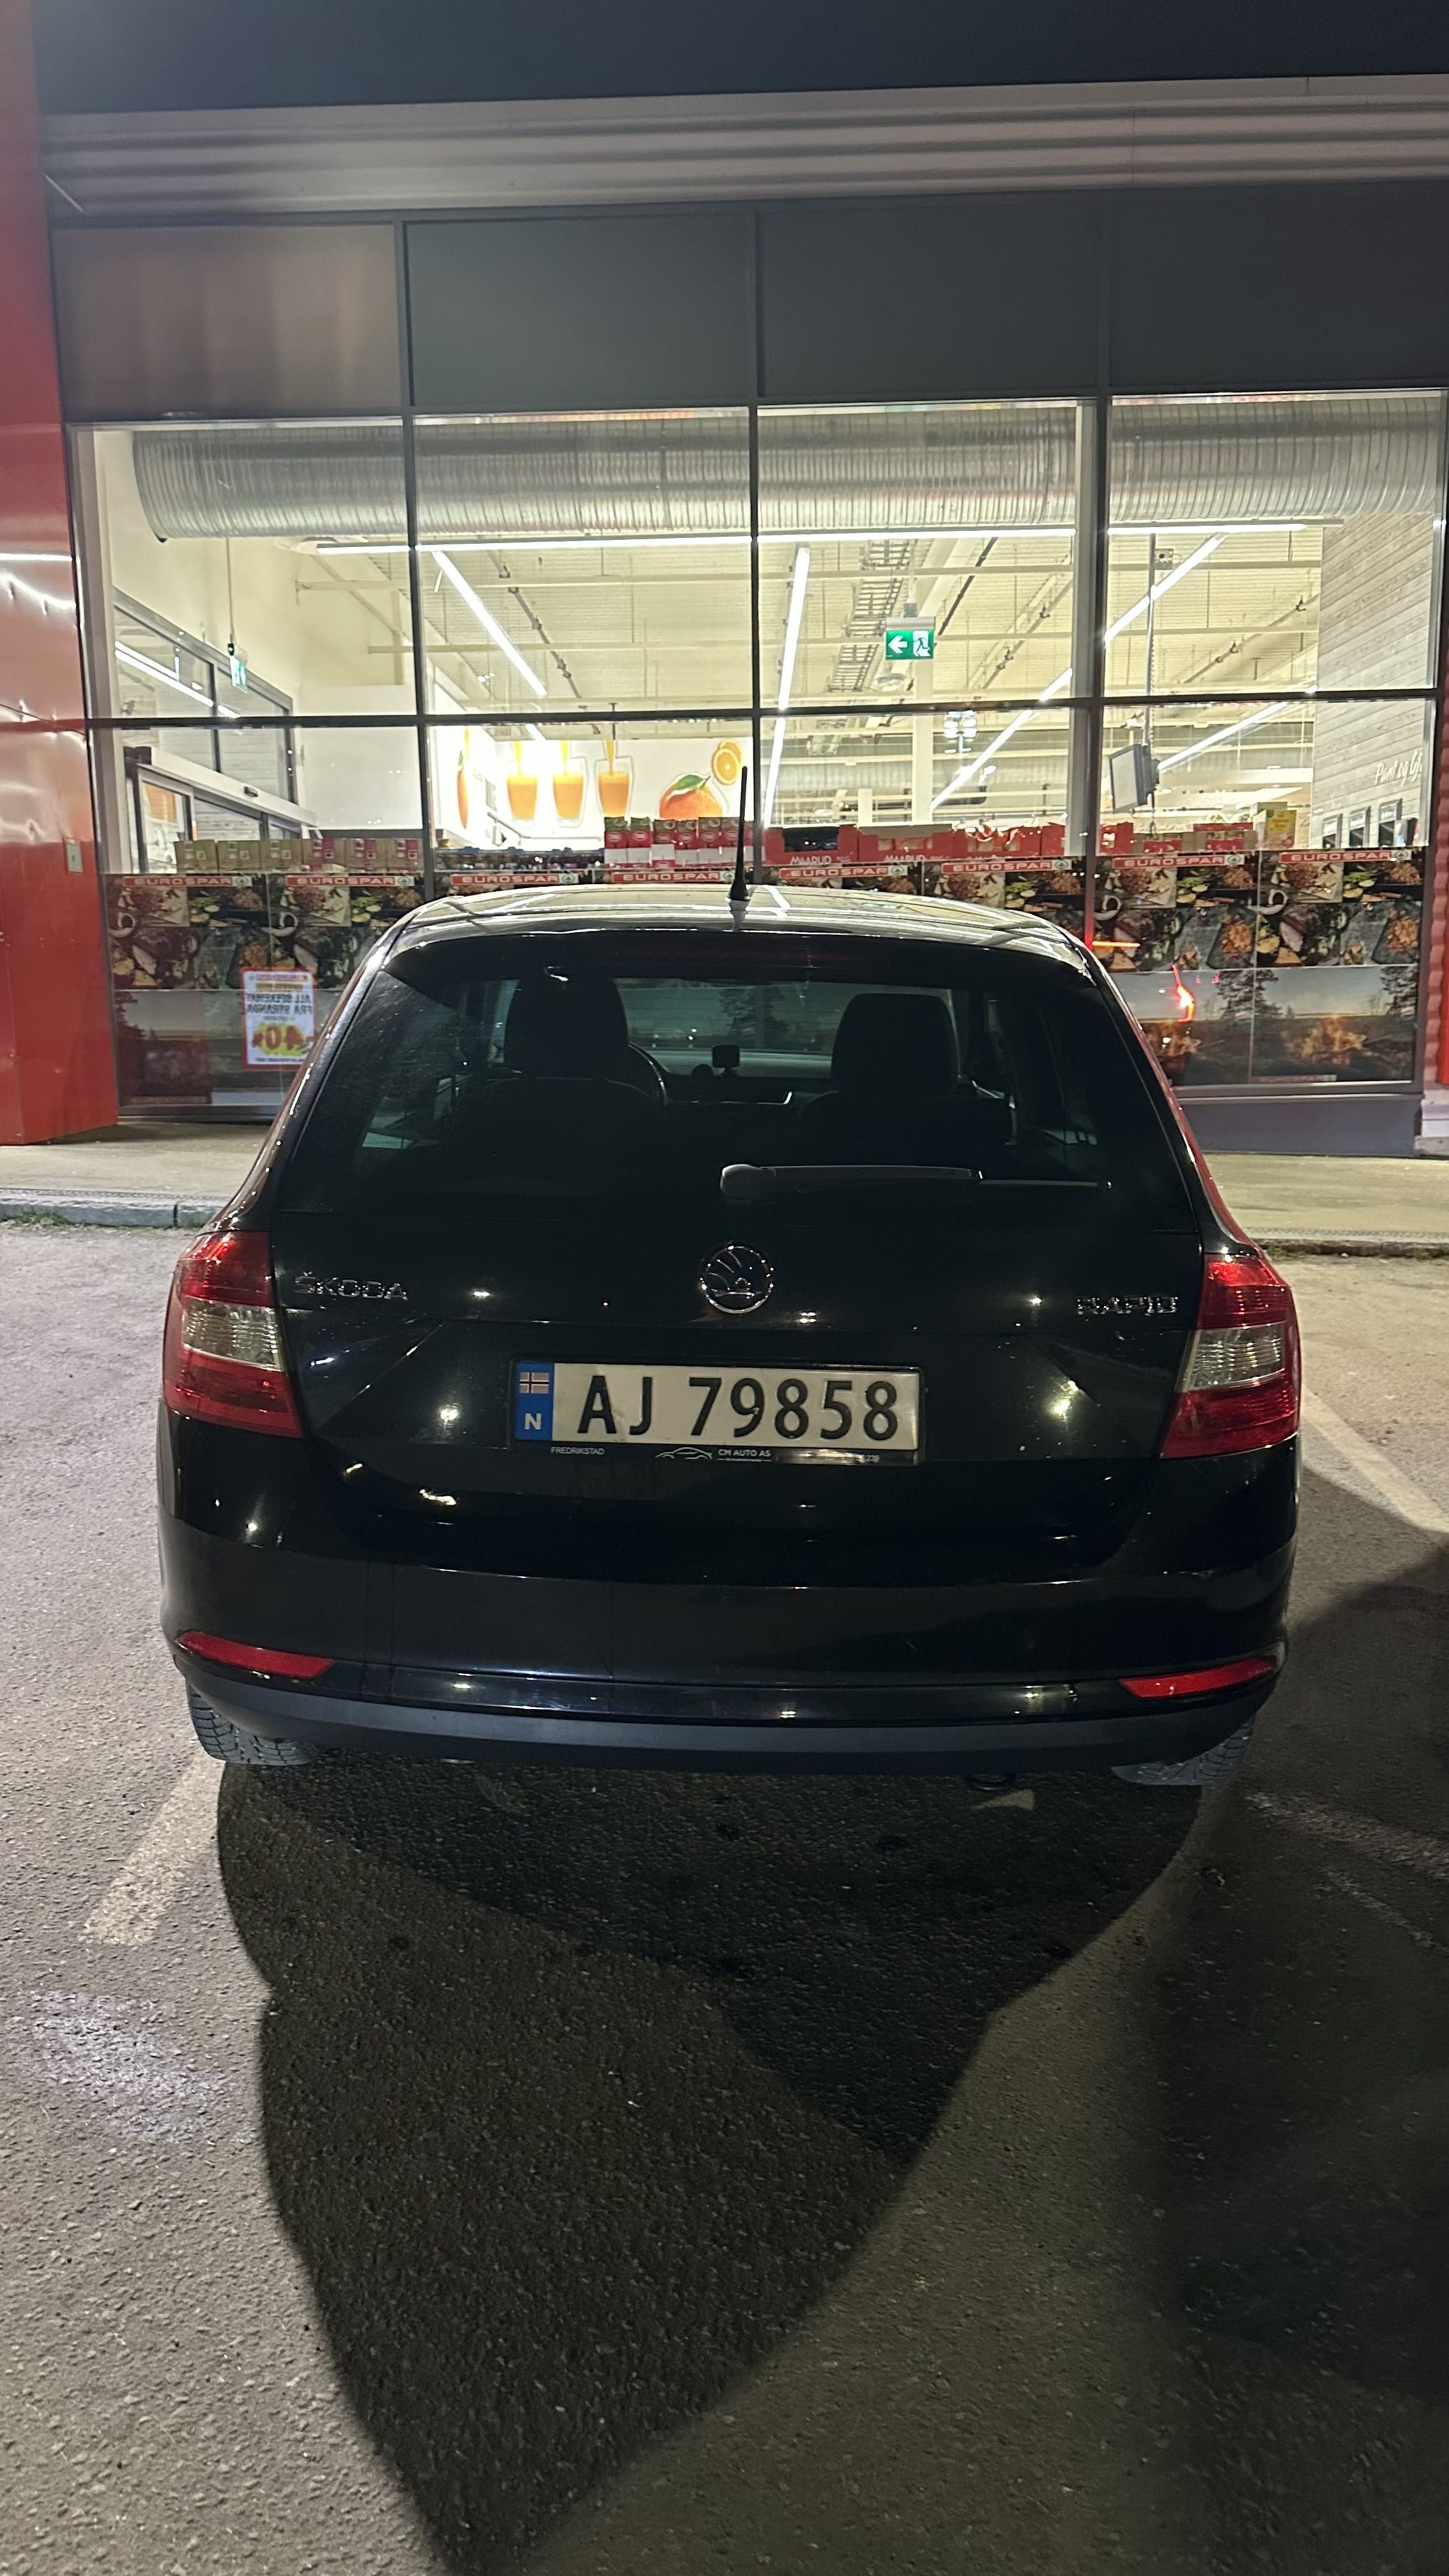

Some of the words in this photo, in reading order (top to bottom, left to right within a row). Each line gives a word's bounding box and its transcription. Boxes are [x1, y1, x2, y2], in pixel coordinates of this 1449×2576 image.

[790, 855, 832, 865] MAARUD
[1124, 857, 1224, 867] EUROSPAR
[1291, 852, 1391, 862] EUROSPAR
[953, 862, 1052, 872] EUROSPAR
[623, 873, 719, 882] EUROSPAR
[790, 868, 888, 877] EUROSPAR
[134, 877, 232, 885] EUROSPAR
[296, 877, 394, 885] EUROSPAR
[462, 875, 558, 884] EUROSPAR
[577, 1375, 653, 1436] AJ
[688, 1376, 898, 1441] 79858
[524, 1413, 542, 1430] N
[551, 1446, 606, 1455] FREDRIKSTAD
[717, 1448, 732, 1457] CM
[733, 1449, 757, 1457] AUTO
[758, 1450, 772, 1458] AS
